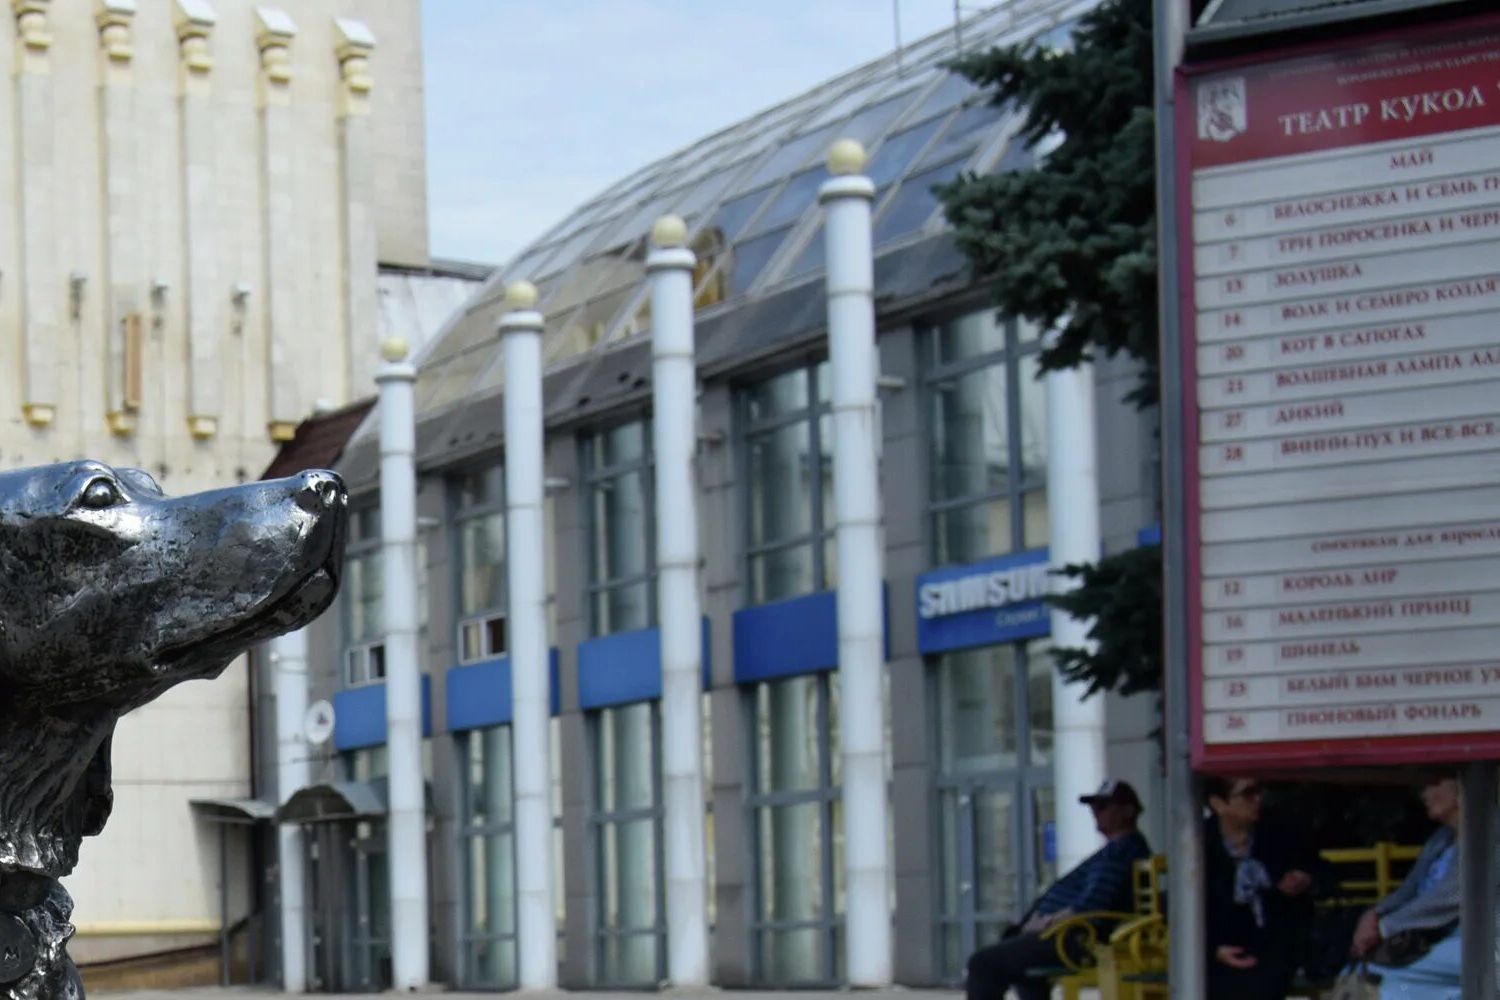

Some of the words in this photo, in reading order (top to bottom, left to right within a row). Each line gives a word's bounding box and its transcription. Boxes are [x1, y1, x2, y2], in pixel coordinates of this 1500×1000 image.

[1278, 102, 1369, 135] ТЕАТР
[1380, 85, 1484, 122] КУКОЛ
[1390, 149, 1433, 169] МАЙ
[1274, 188, 1398, 220] БЕЛОСНЕЖКА
[1405, 186, 1420, 201] И
[1426, 179, 1478, 200] СЕМЬ
[1278, 237, 1314, 253] ТРИ
[1440, 218, 1454, 234] И
[1274, 263, 1362, 288] ЗОЛУШКА
[1282, 304, 1328, 321] ВОЛК
[1337, 300, 1350, 315] И
[1356, 289, 1430, 311] СЕМЕРО
[1282, 337, 1317, 354] КОТ
[1324, 334, 1335, 348] В
[1340, 325, 1425, 346] САПОГАХ
[1277, 363, 1387, 387] ВОЛШЕБНАЯ
[1395, 354, 1462, 375] ЛАМПА
[1400, 429, 1414, 443] И
[919, 561, 1051, 619] SAMSUN
[1283, 572, 1354, 592] КОРОЛЬ
[1360, 569, 1397, 586] ЛИР
[1279, 600, 1394, 625] МАЛЕНЬКИЙ
[1402, 597, 1471, 617] ПРИНЦ
[1287, 675, 1348, 693] БЕЛЫЙ
[1403, 669, 1474, 685] ЧЕРНОЕ
[1404, 702, 1481, 721] ФОНАРЬ
